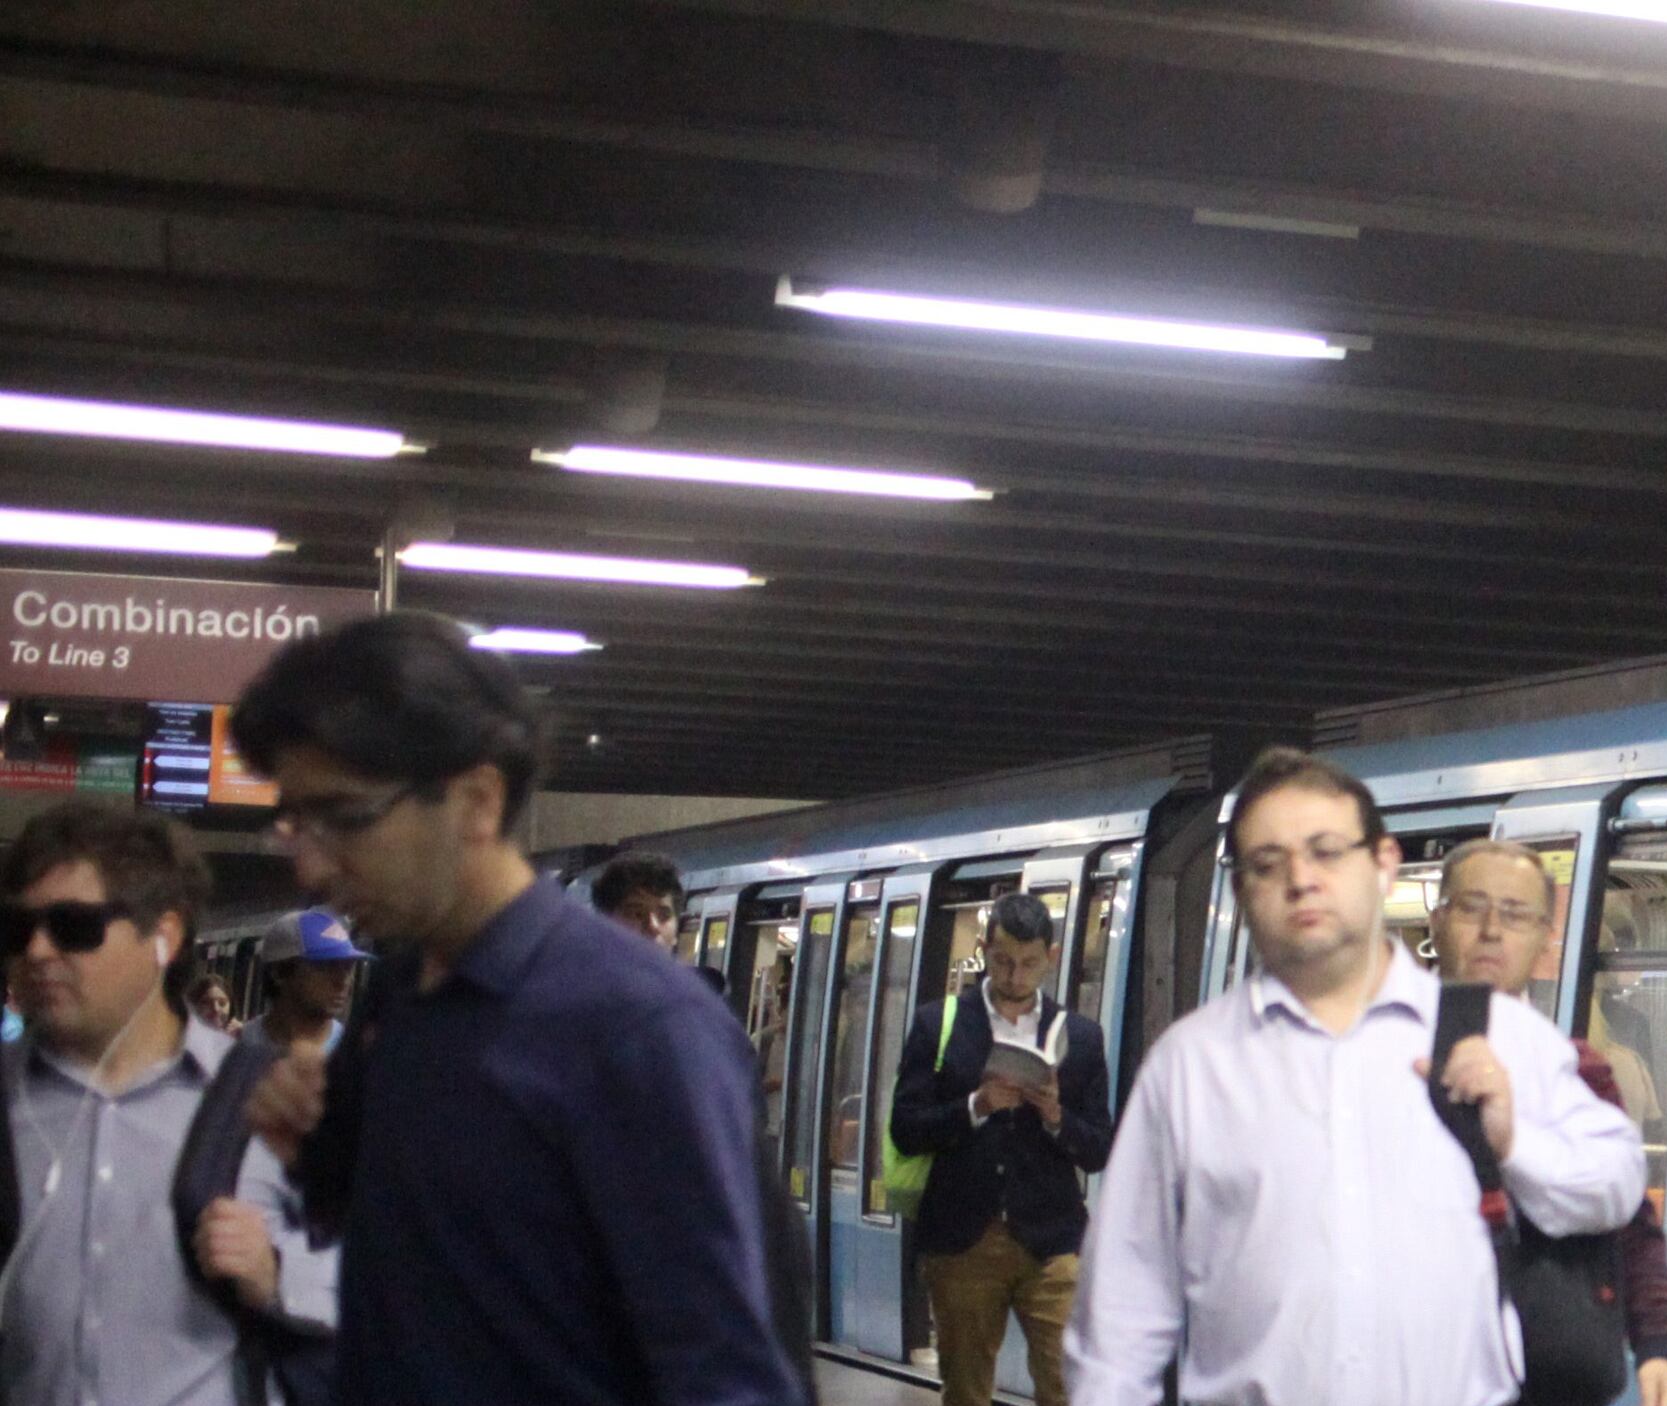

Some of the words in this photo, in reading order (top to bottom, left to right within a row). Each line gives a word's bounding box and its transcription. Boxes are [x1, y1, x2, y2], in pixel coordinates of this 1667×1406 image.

[12, 590, 320, 641] Combinación
[10, 640, 40, 664] To
[48, 642, 105, 667] Line
[112, 646, 131, 669] 3
